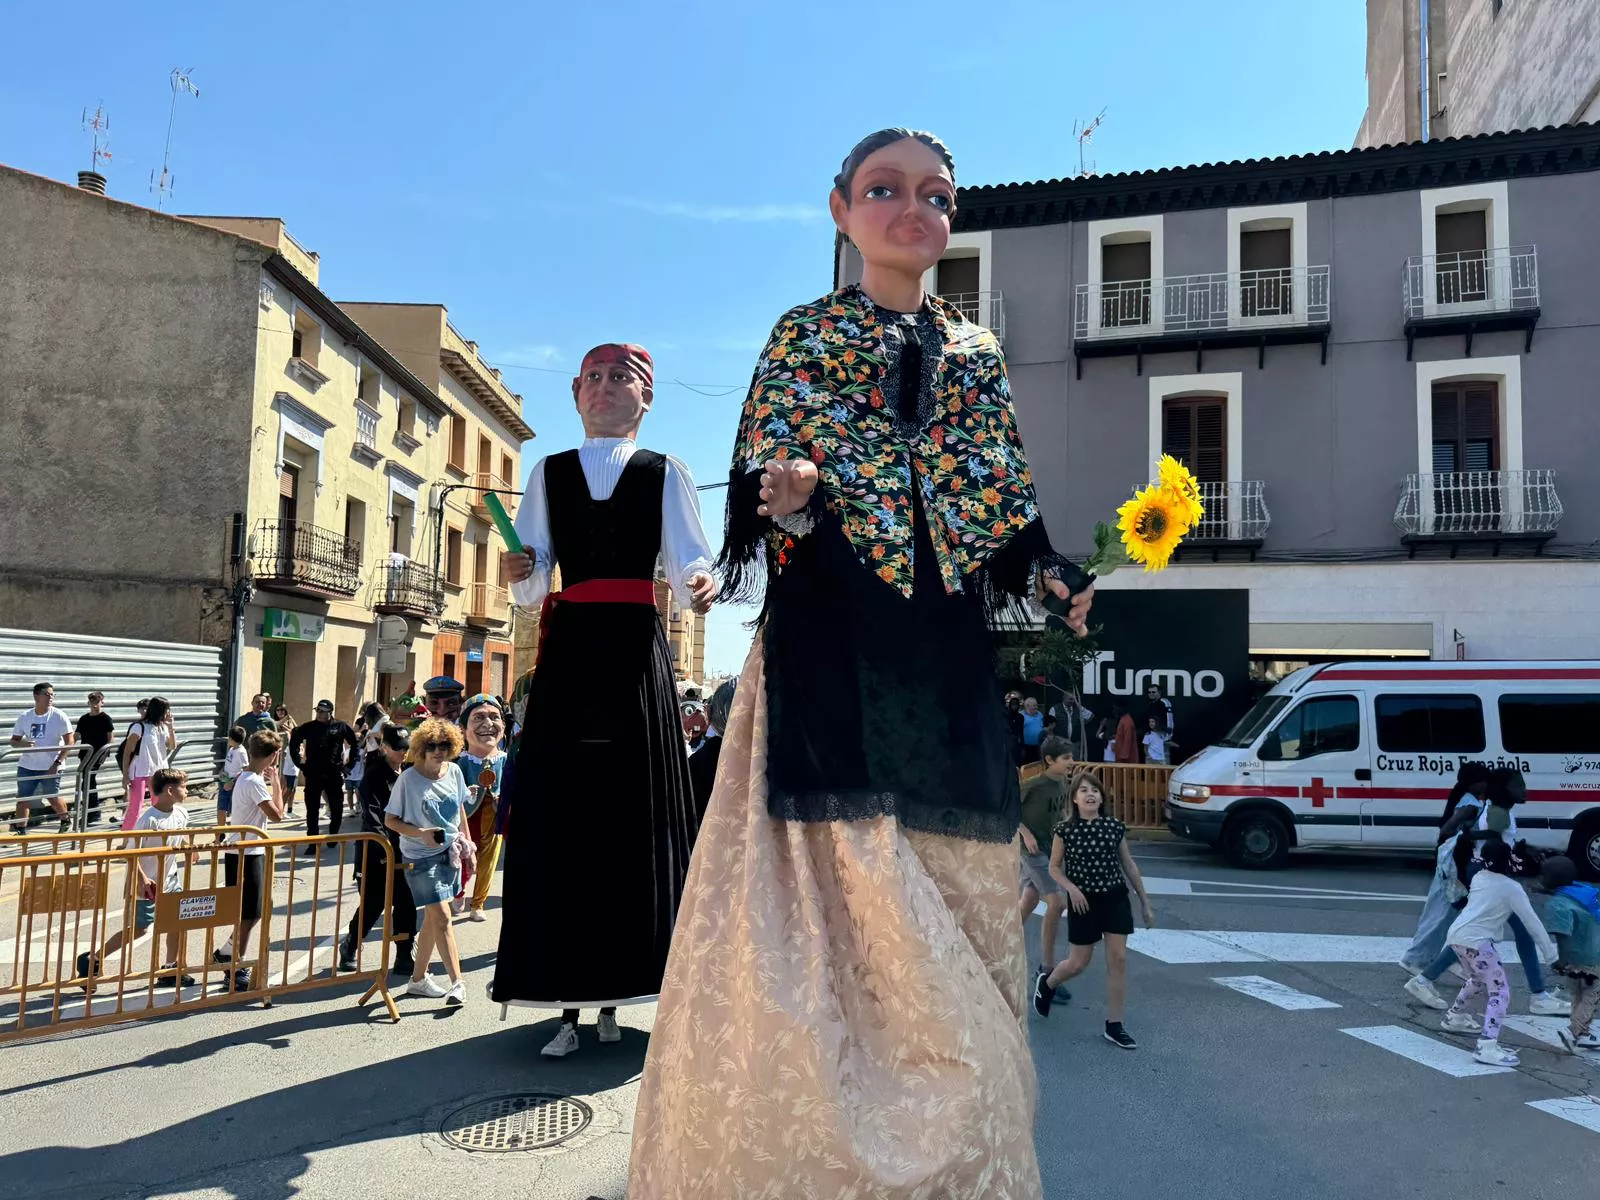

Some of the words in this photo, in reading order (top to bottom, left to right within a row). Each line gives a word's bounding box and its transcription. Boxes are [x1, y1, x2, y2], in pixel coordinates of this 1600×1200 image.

[1078, 651, 1224, 698] Turmo
[1377, 755, 1413, 770] Cruz
[1418, 755, 1454, 776] Roja
[1458, 755, 1531, 773] Eañola
[1584, 761, 1600, 770] 974
[181, 896, 215, 905] CLAVERIA
[182, 905, 213, 913] ALQUILER
